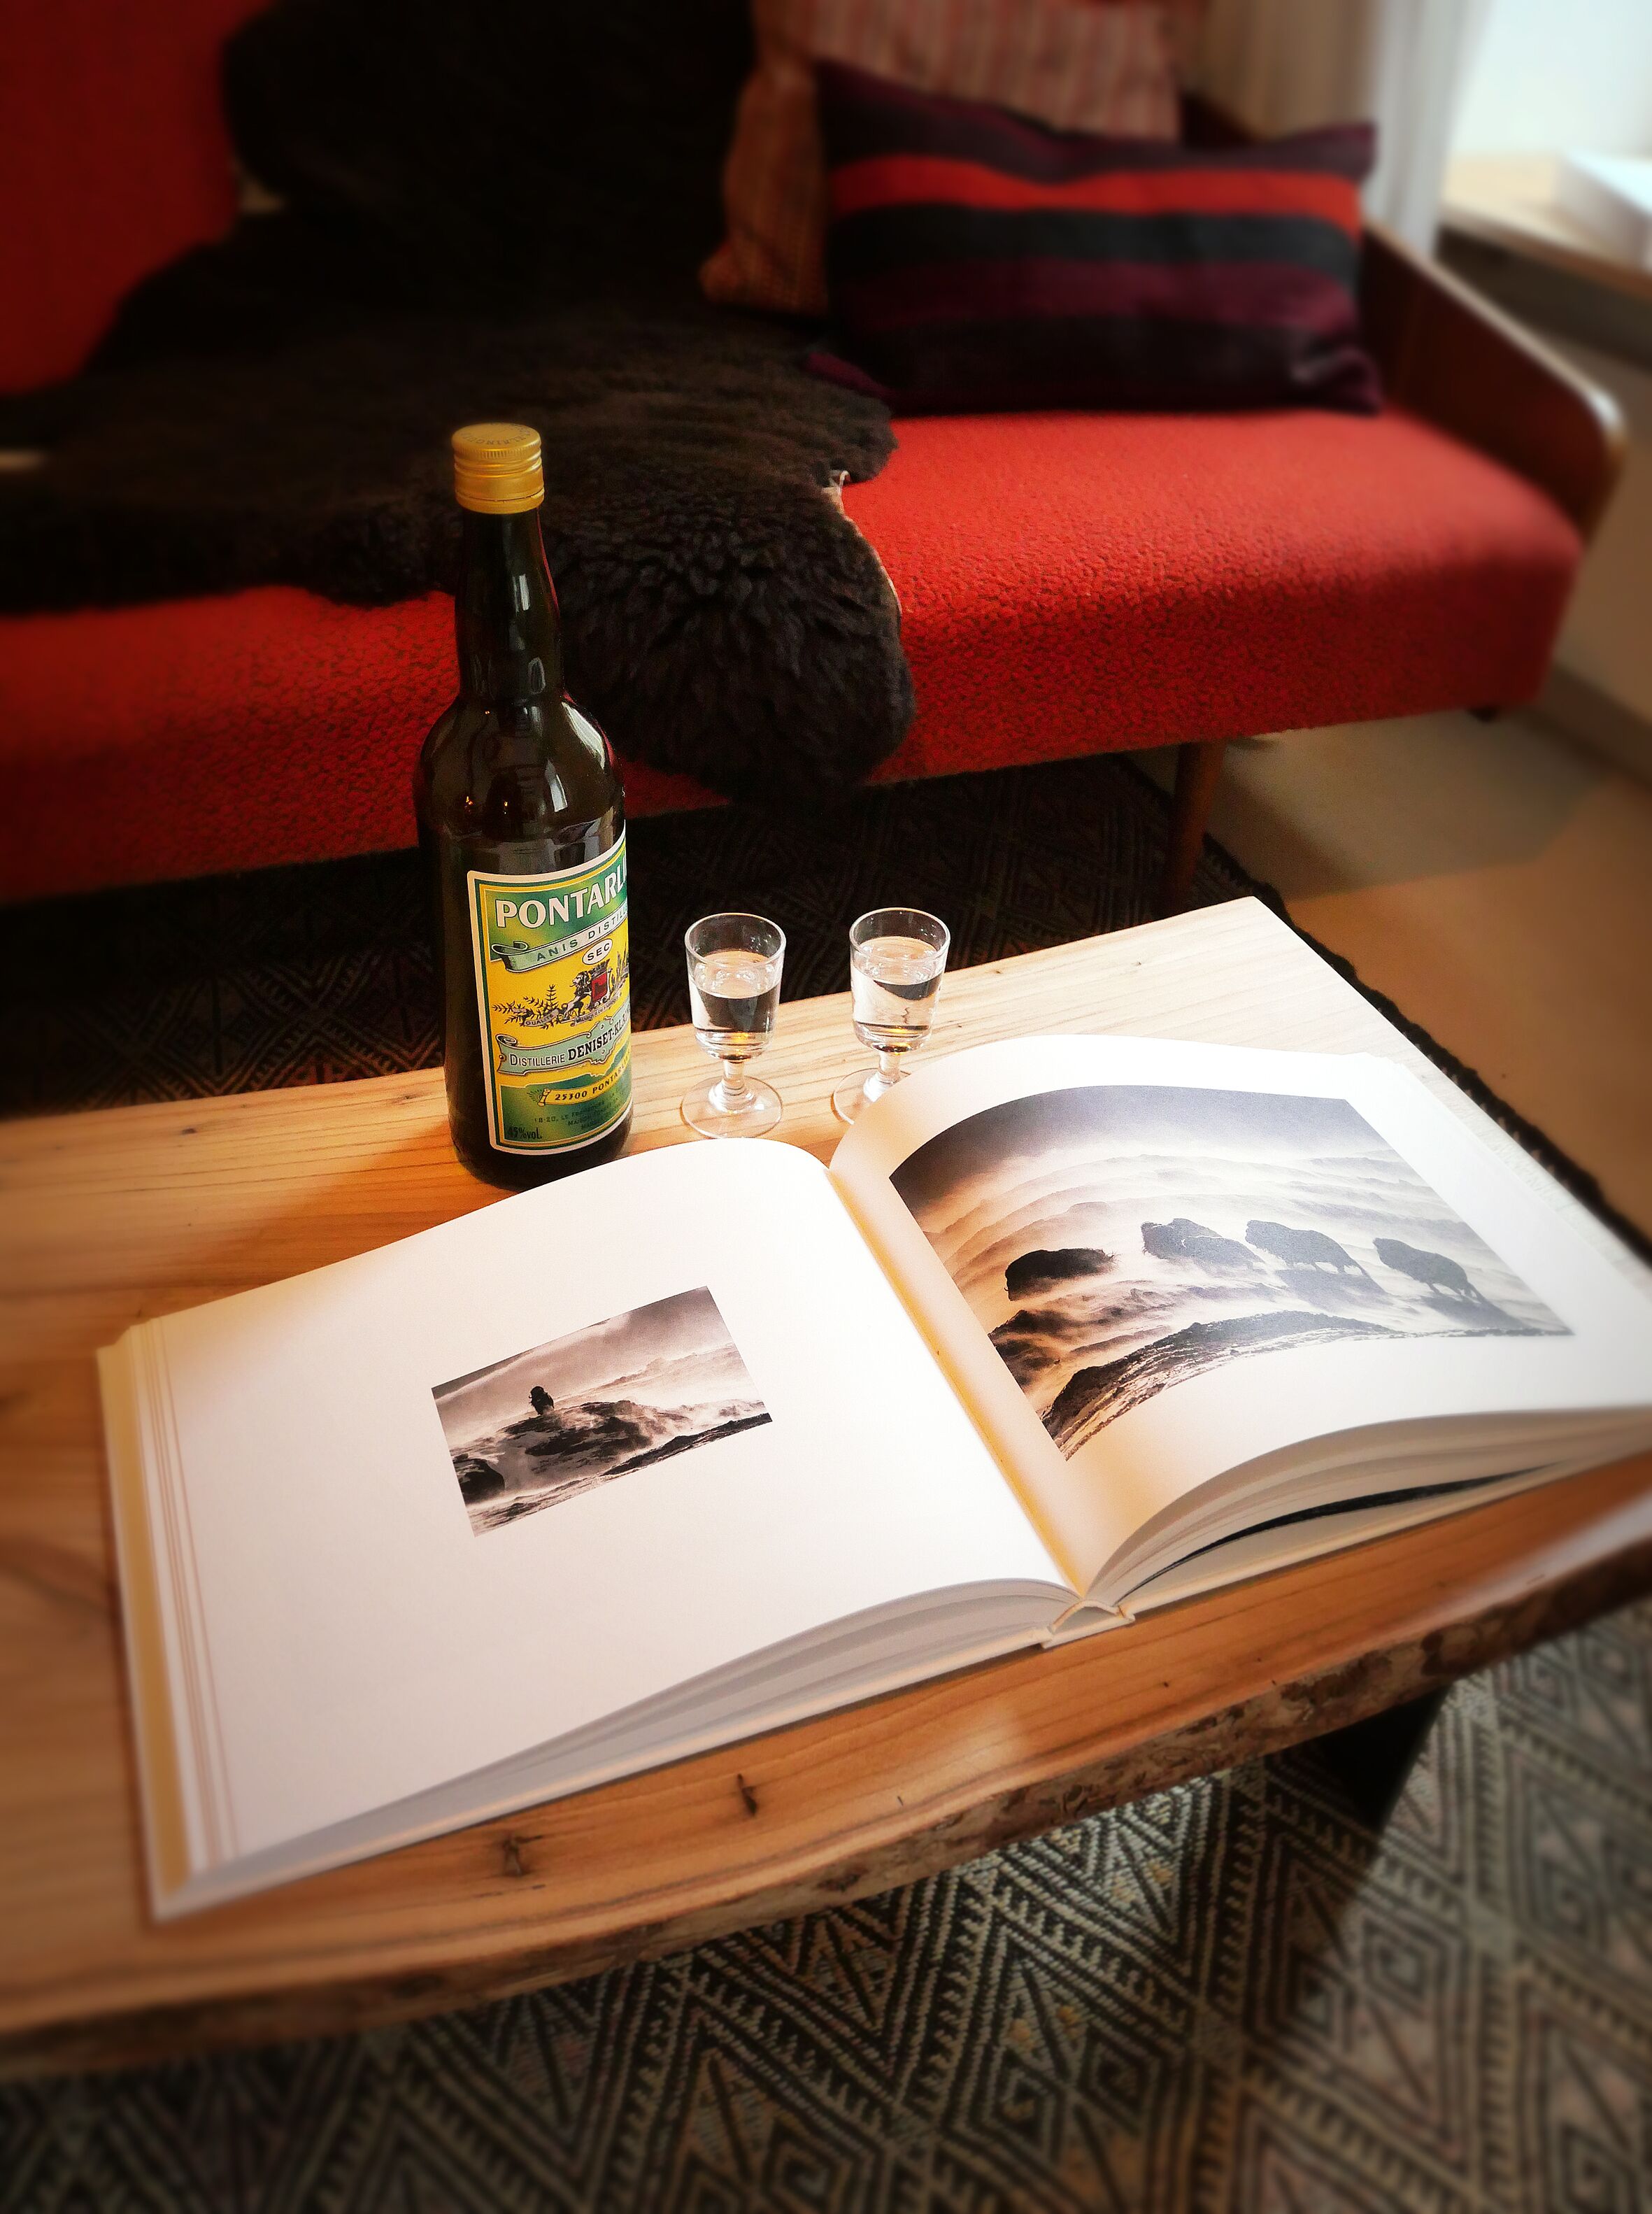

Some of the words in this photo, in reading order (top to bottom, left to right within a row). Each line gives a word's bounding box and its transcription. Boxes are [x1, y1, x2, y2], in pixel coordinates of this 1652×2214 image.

[536, 939, 578, 962] ANIS
[588, 942, 610, 961] SEC
[555, 1091, 588, 1102] 25300
